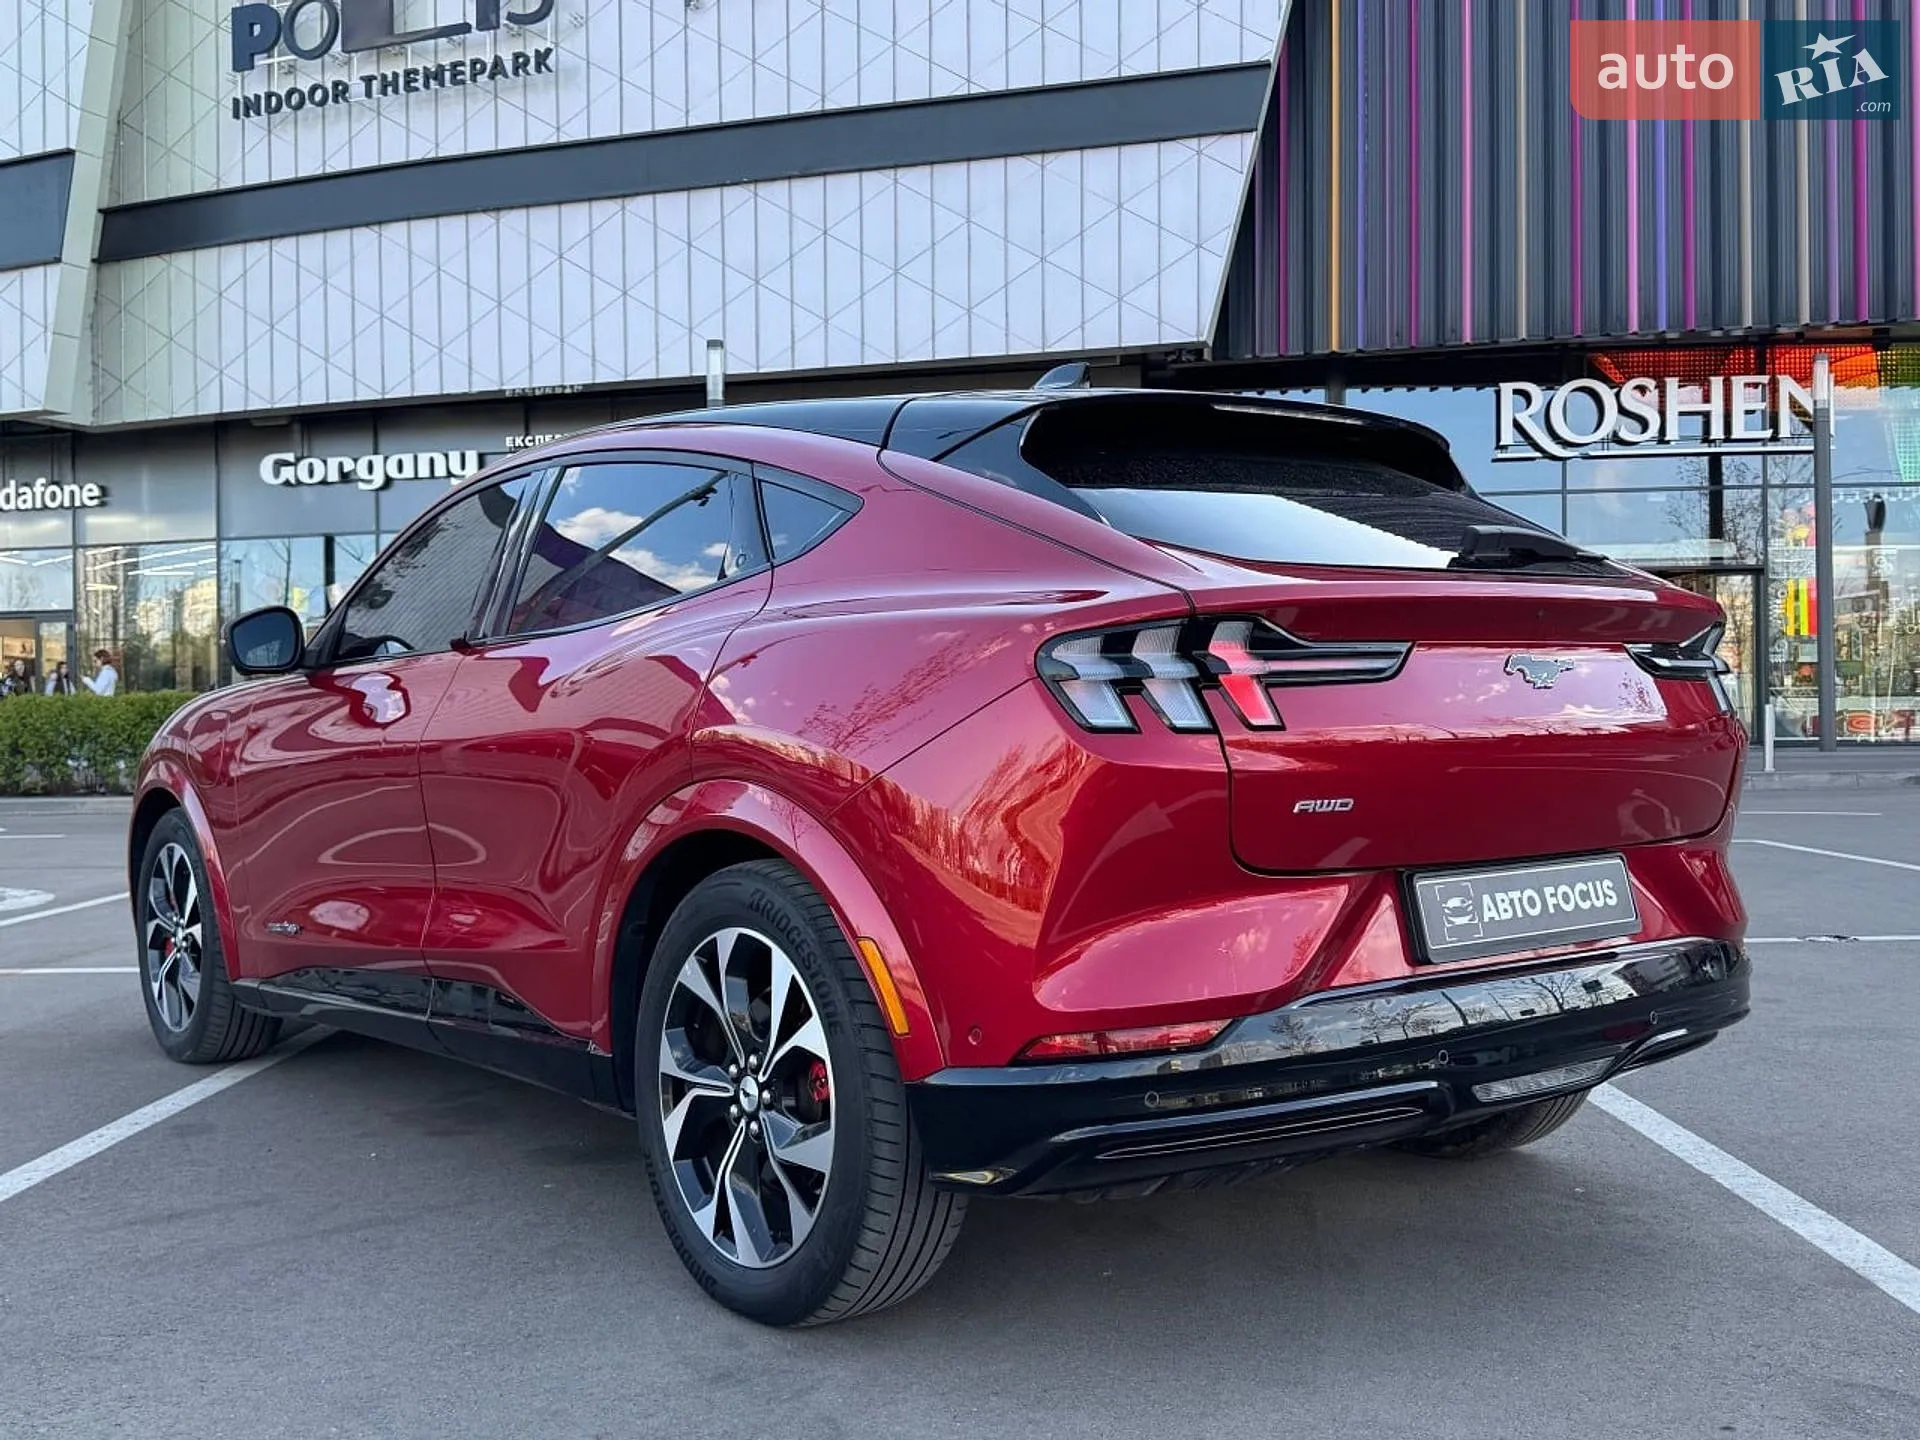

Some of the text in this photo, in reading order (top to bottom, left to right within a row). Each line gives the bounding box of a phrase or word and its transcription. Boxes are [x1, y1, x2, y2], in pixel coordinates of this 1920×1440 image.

[232, 47, 554, 120] INDOOR THEMEPARK
[1498, 370, 1837, 459] ROSHEN
[259, 449, 479, 491] Gorgany
[1293, 797, 1354, 813] AWD
[1543, 878, 1618, 914] FOCUS
[747, 886, 844, 1036] BRIDGESTONE
